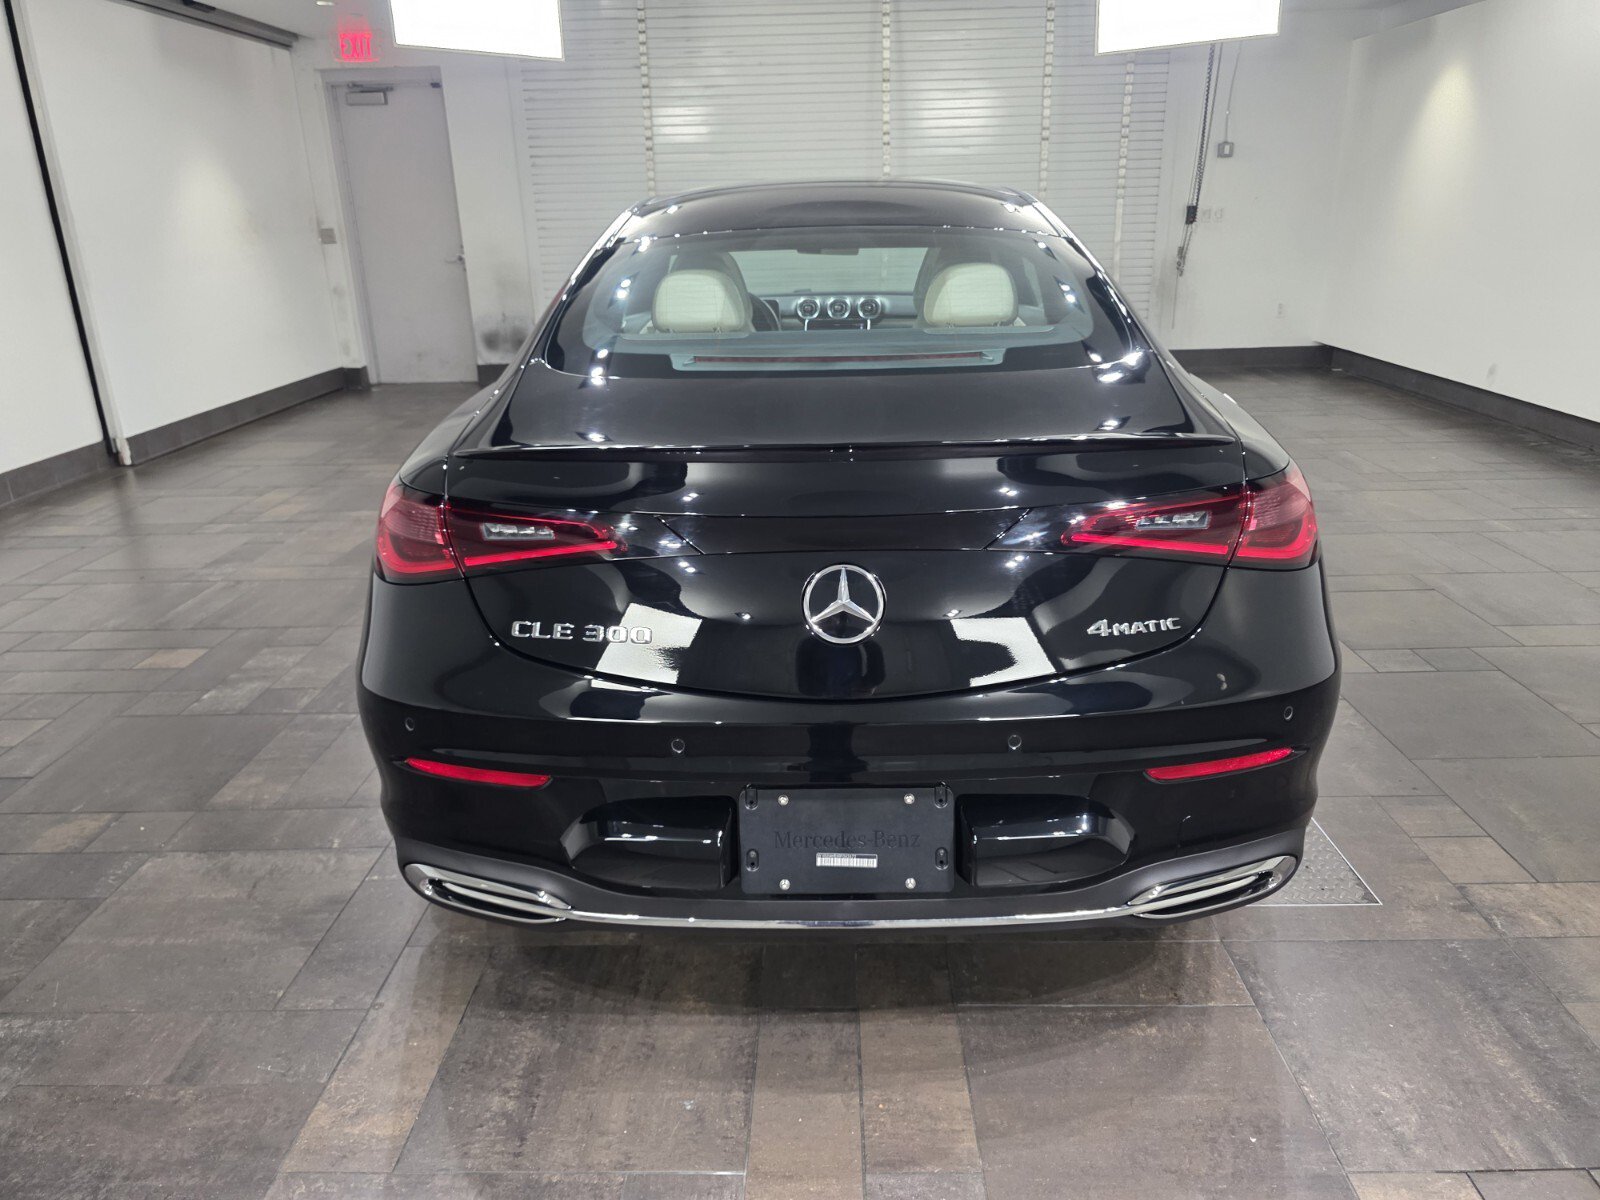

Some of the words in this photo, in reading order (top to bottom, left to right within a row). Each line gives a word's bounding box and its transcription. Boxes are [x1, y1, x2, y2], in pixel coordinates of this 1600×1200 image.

[339, 33, 372, 59] EXIT
[511, 620, 575, 640] CLE
[582, 624, 653, 644] 300
[1086, 617, 1181, 637] 4MATIC
[774, 830, 921, 849] Mercedes-Benz
